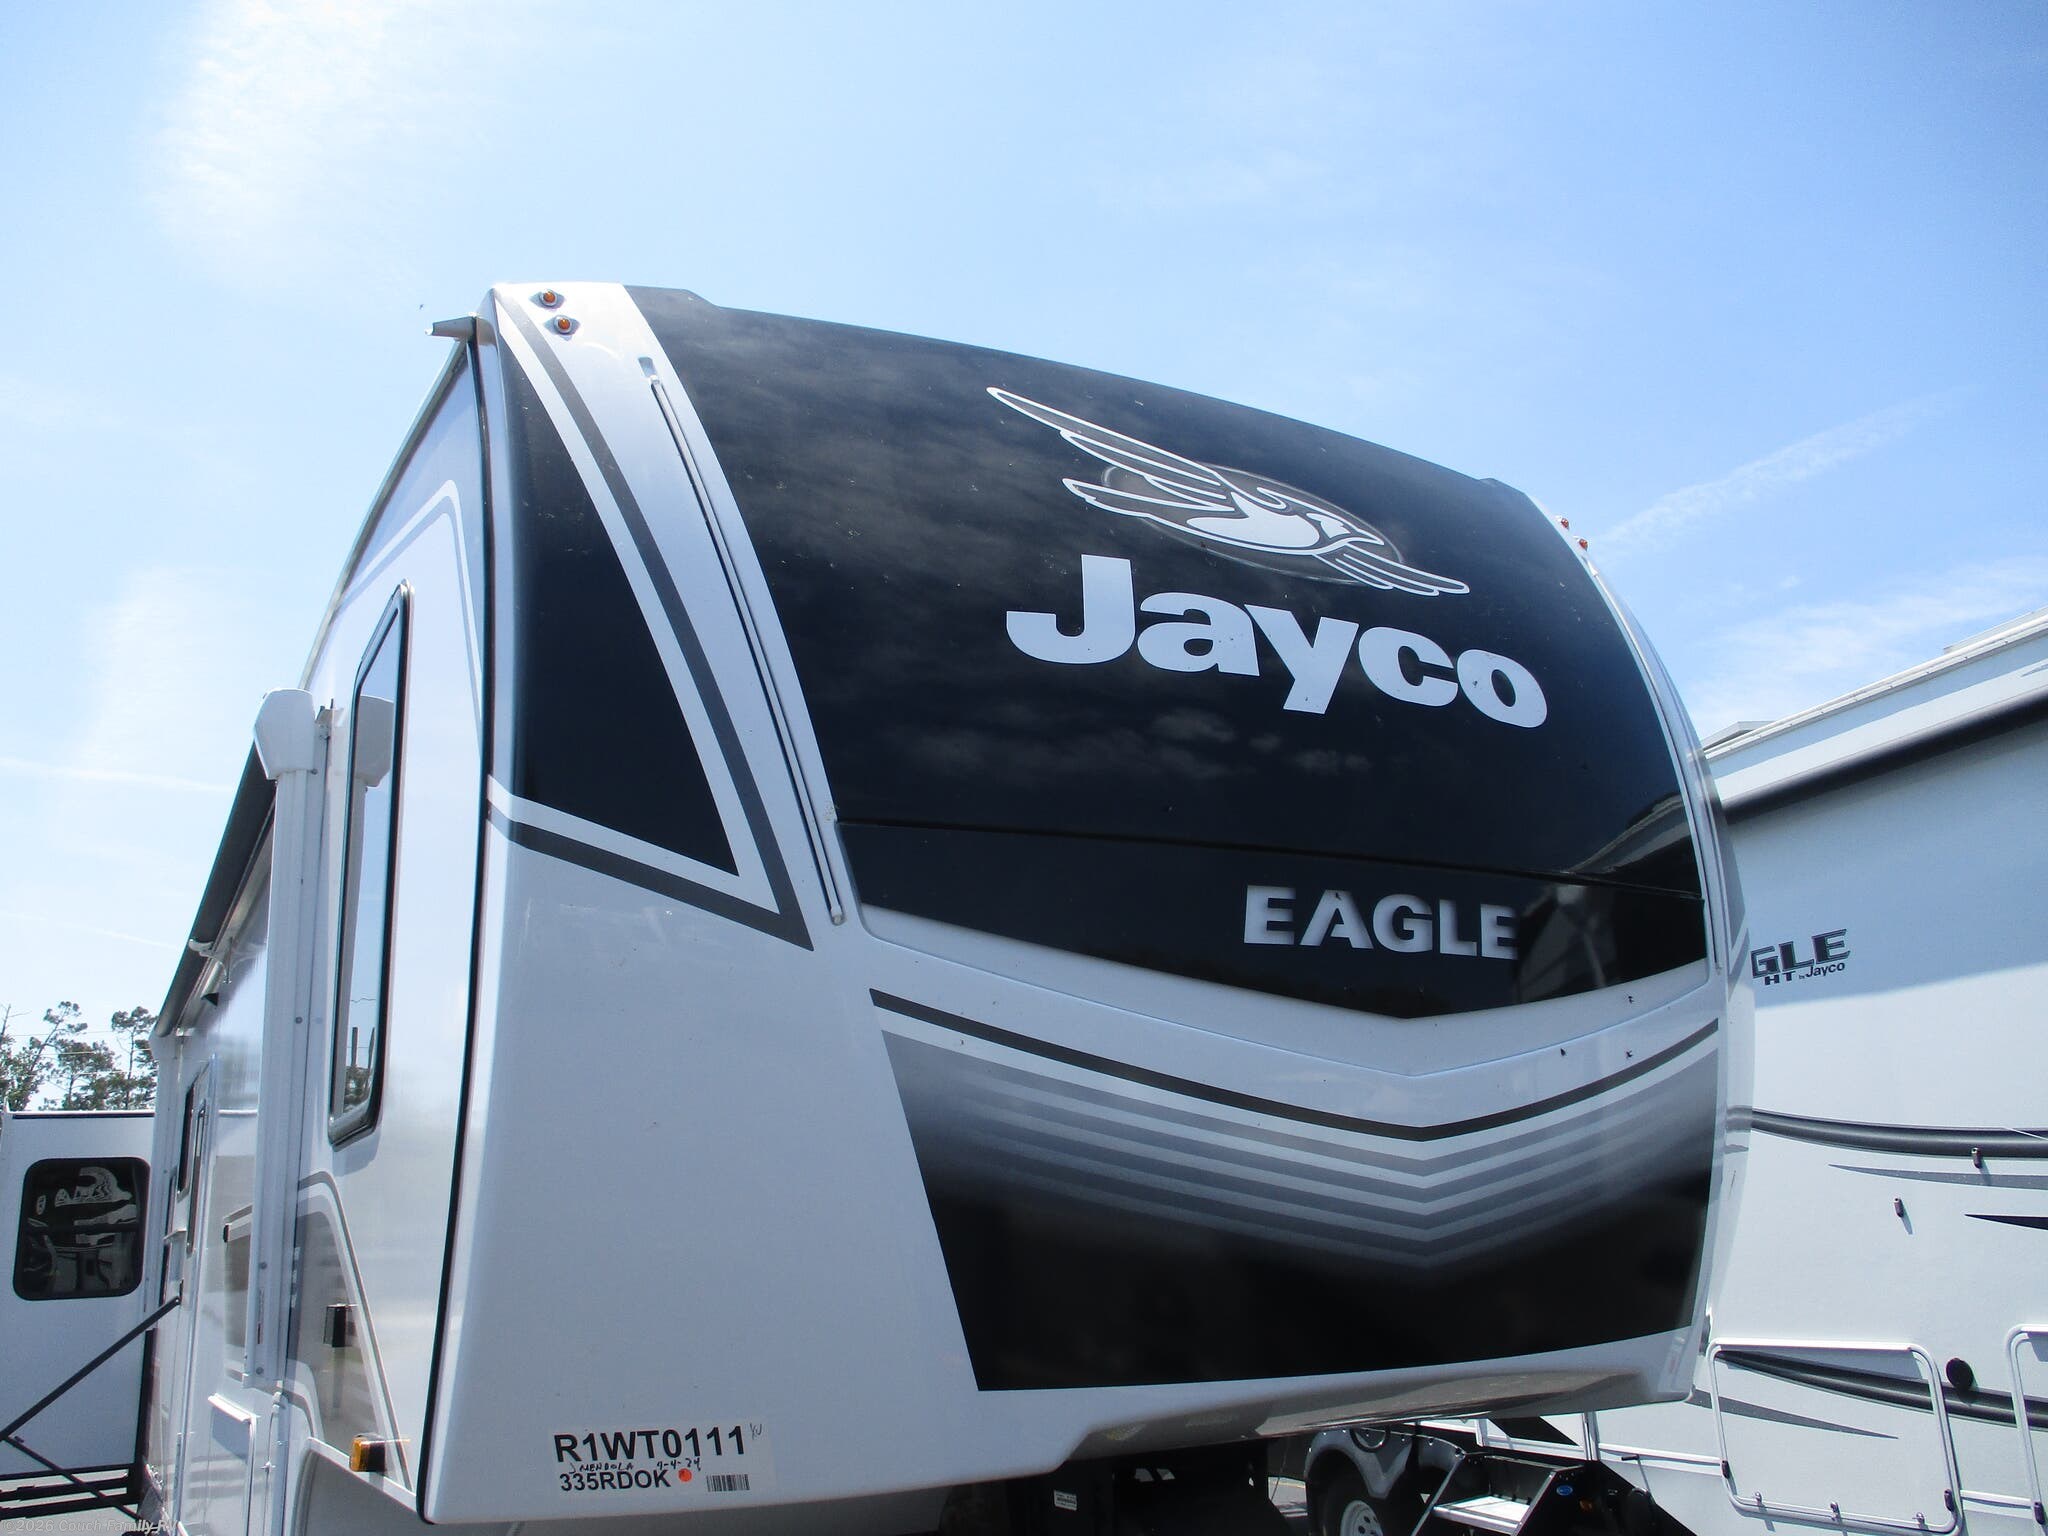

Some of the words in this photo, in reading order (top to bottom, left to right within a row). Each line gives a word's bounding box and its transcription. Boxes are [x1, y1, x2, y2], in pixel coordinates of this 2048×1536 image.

[1006, 554, 1548, 728] Jayco
[1243, 884, 1520, 961] EAGLE
[1764, 970, 1796, 986] HT
[1805, 962, 1846, 978] Jayco
[554, 1425, 745, 1463] R1WT0111
[559, 1469, 672, 1492] 335RDOK
